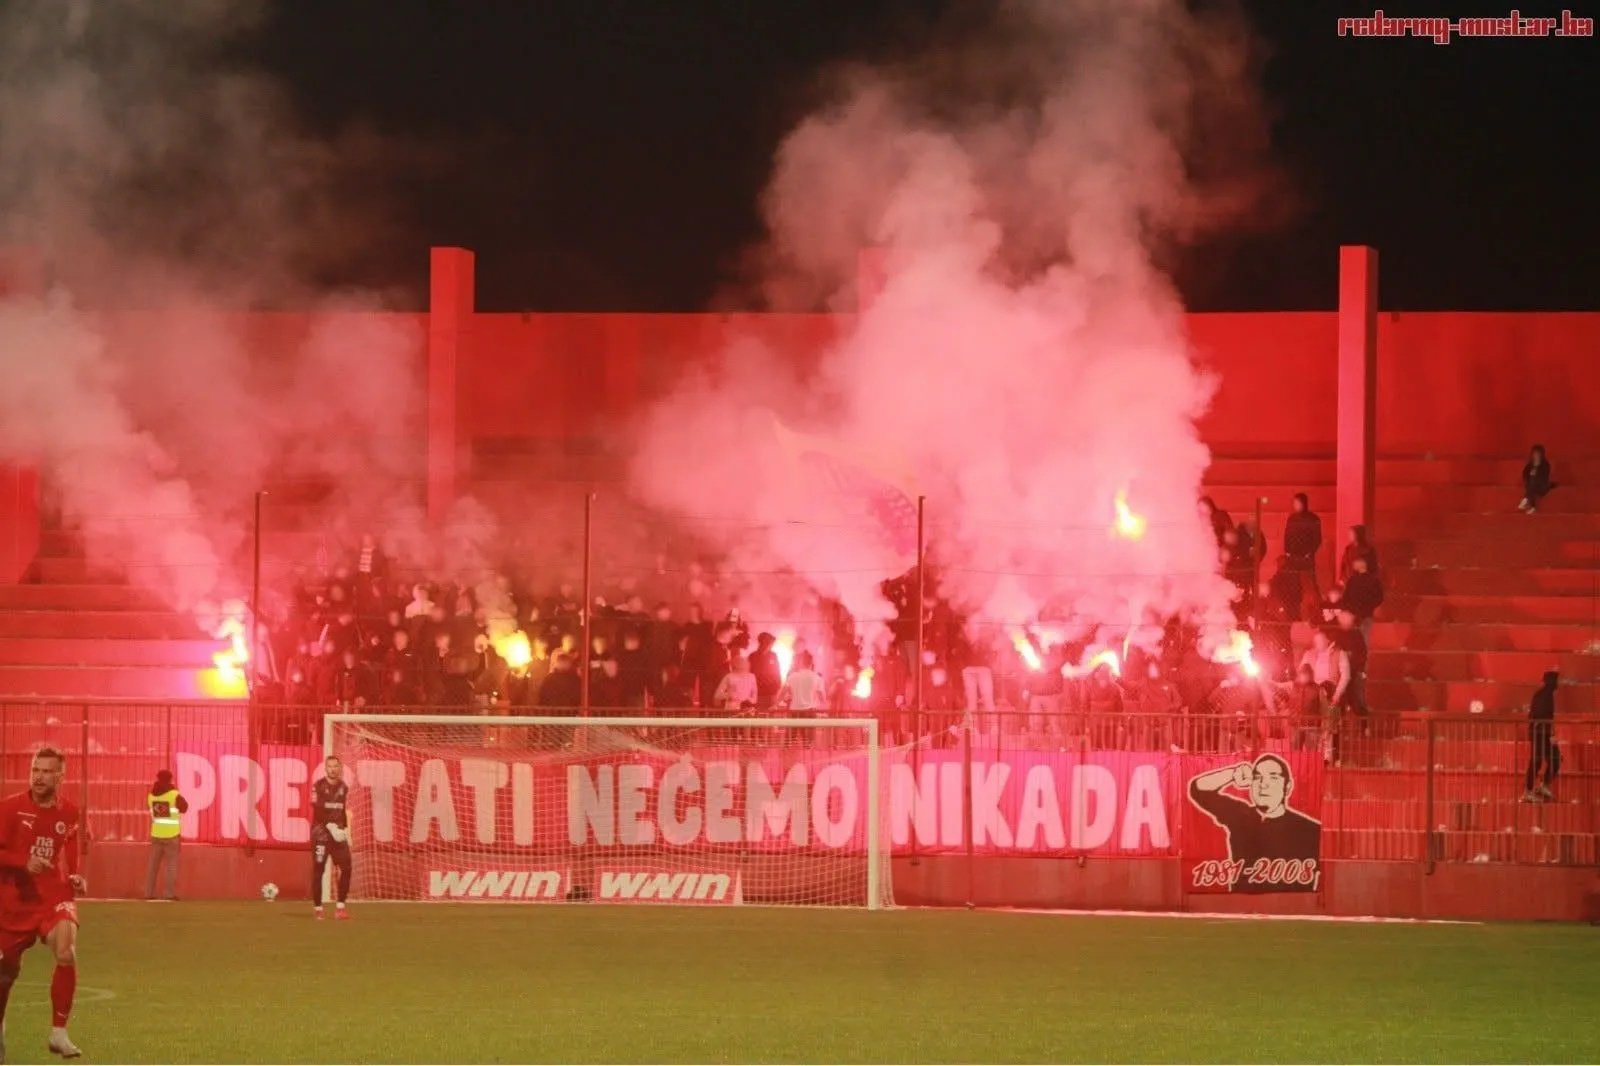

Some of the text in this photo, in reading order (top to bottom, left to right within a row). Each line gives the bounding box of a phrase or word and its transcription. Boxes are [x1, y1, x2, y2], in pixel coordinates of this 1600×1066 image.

[174, 752, 533, 845] PRETATI
[890, 761, 1171, 849] NIKADA
[36, 836, 53, 847] na
[1192, 857, 1317, 887] 1981-2008
